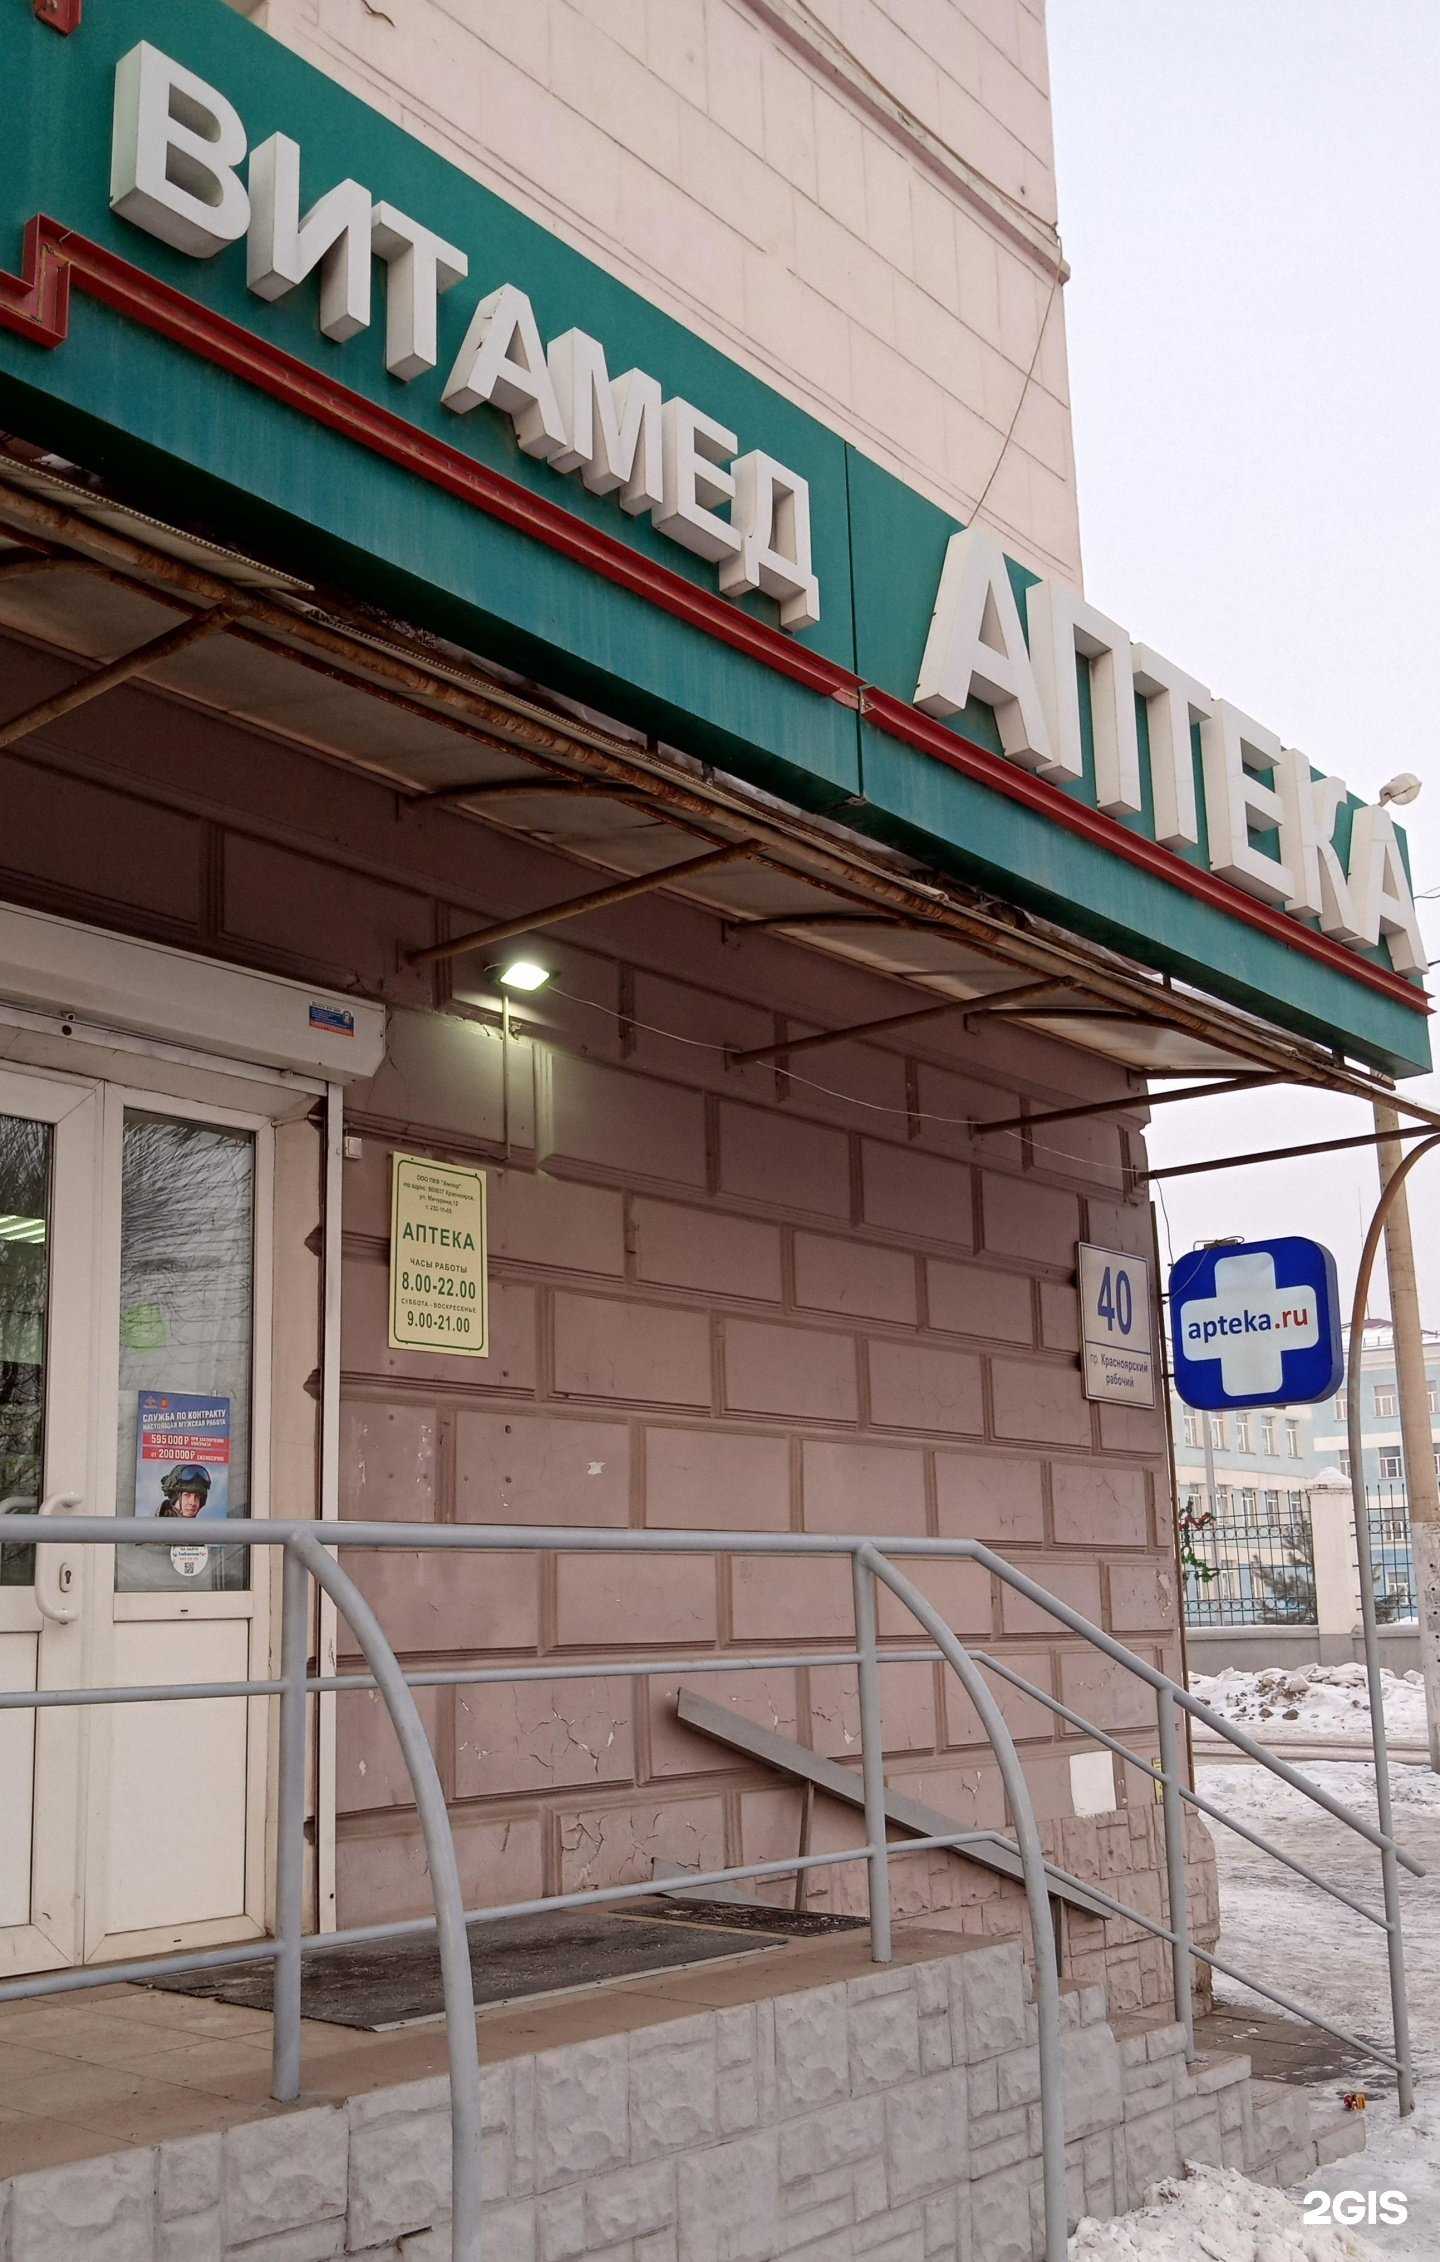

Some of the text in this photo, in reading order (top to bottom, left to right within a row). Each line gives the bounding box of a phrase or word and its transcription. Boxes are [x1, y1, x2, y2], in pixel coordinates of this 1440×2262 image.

[109, 39, 1430, 976] ВИТАМЕД АПТЕКА
[402, 1222, 475, 1251] АПТЕКА
[410, 1257, 467, 1273] ЧАСЫ РАБОТЫ
[402, 1272, 475, 1300] 8.00-22.00
[1097, 1266, 1132, 1335] 40
[407, 1310, 470, 1333] 9.00-21.00
[1188, 1308, 1309, 1344] apteka.ru
[1100, 1353, 1149, 1374] Красноярский
[1105, 1372, 1135, 1388] рабочий
[143, 1409, 226, 1422] СЛУЖБА ПО КОНТРАКТУ
